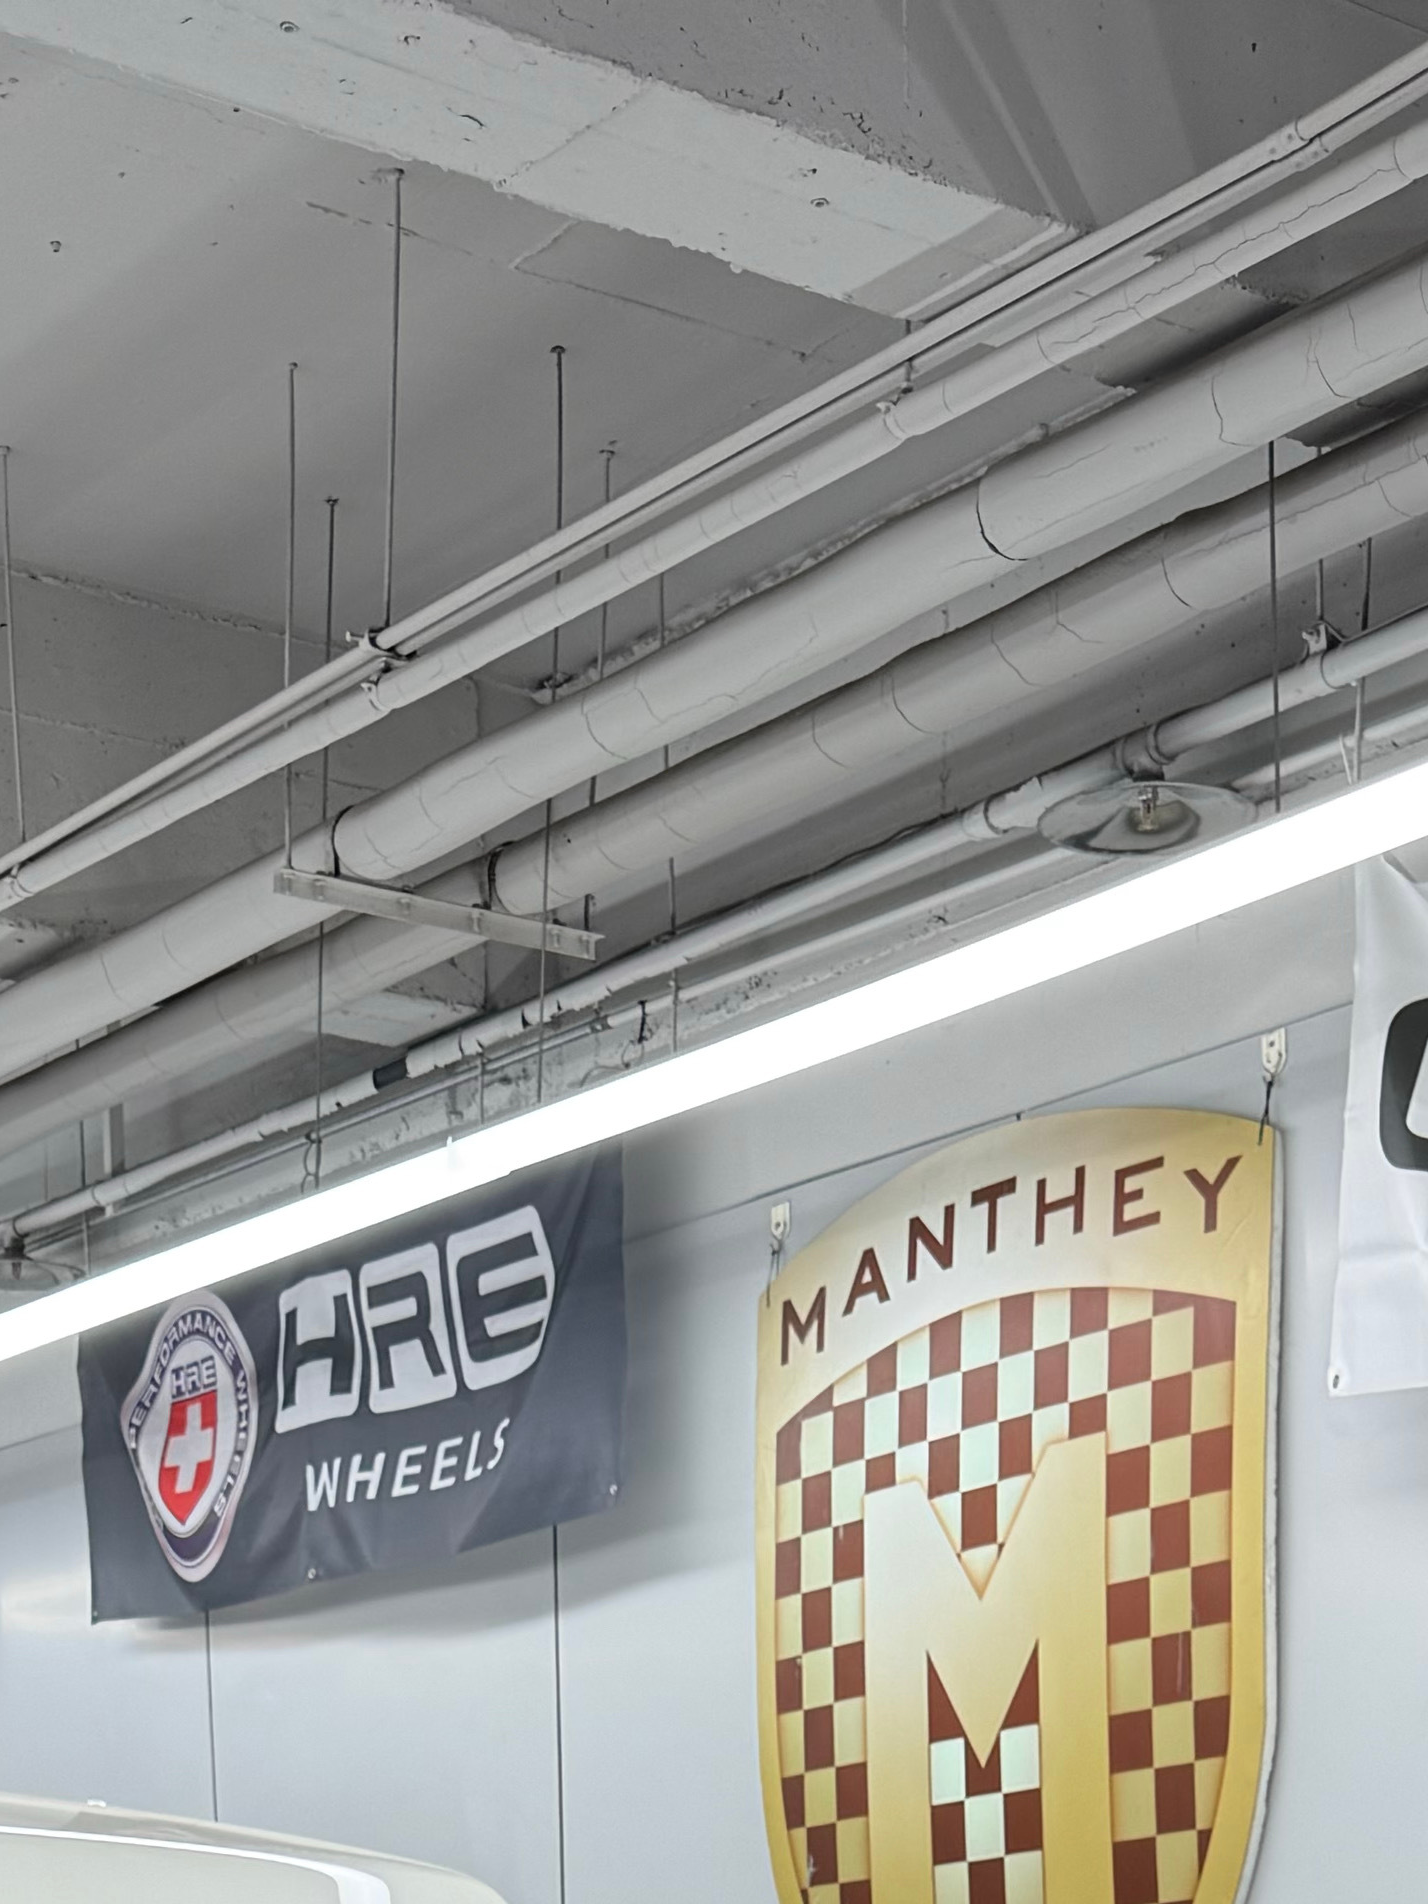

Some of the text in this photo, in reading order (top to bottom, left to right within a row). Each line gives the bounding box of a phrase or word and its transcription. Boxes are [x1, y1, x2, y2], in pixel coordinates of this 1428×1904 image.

[275, 1205, 556, 1433] HRE
[780, 1154, 1243, 1366] MANTHEY
[171, 1355, 217, 1397] HRE
[305, 1417, 510, 1512] WHEELS
